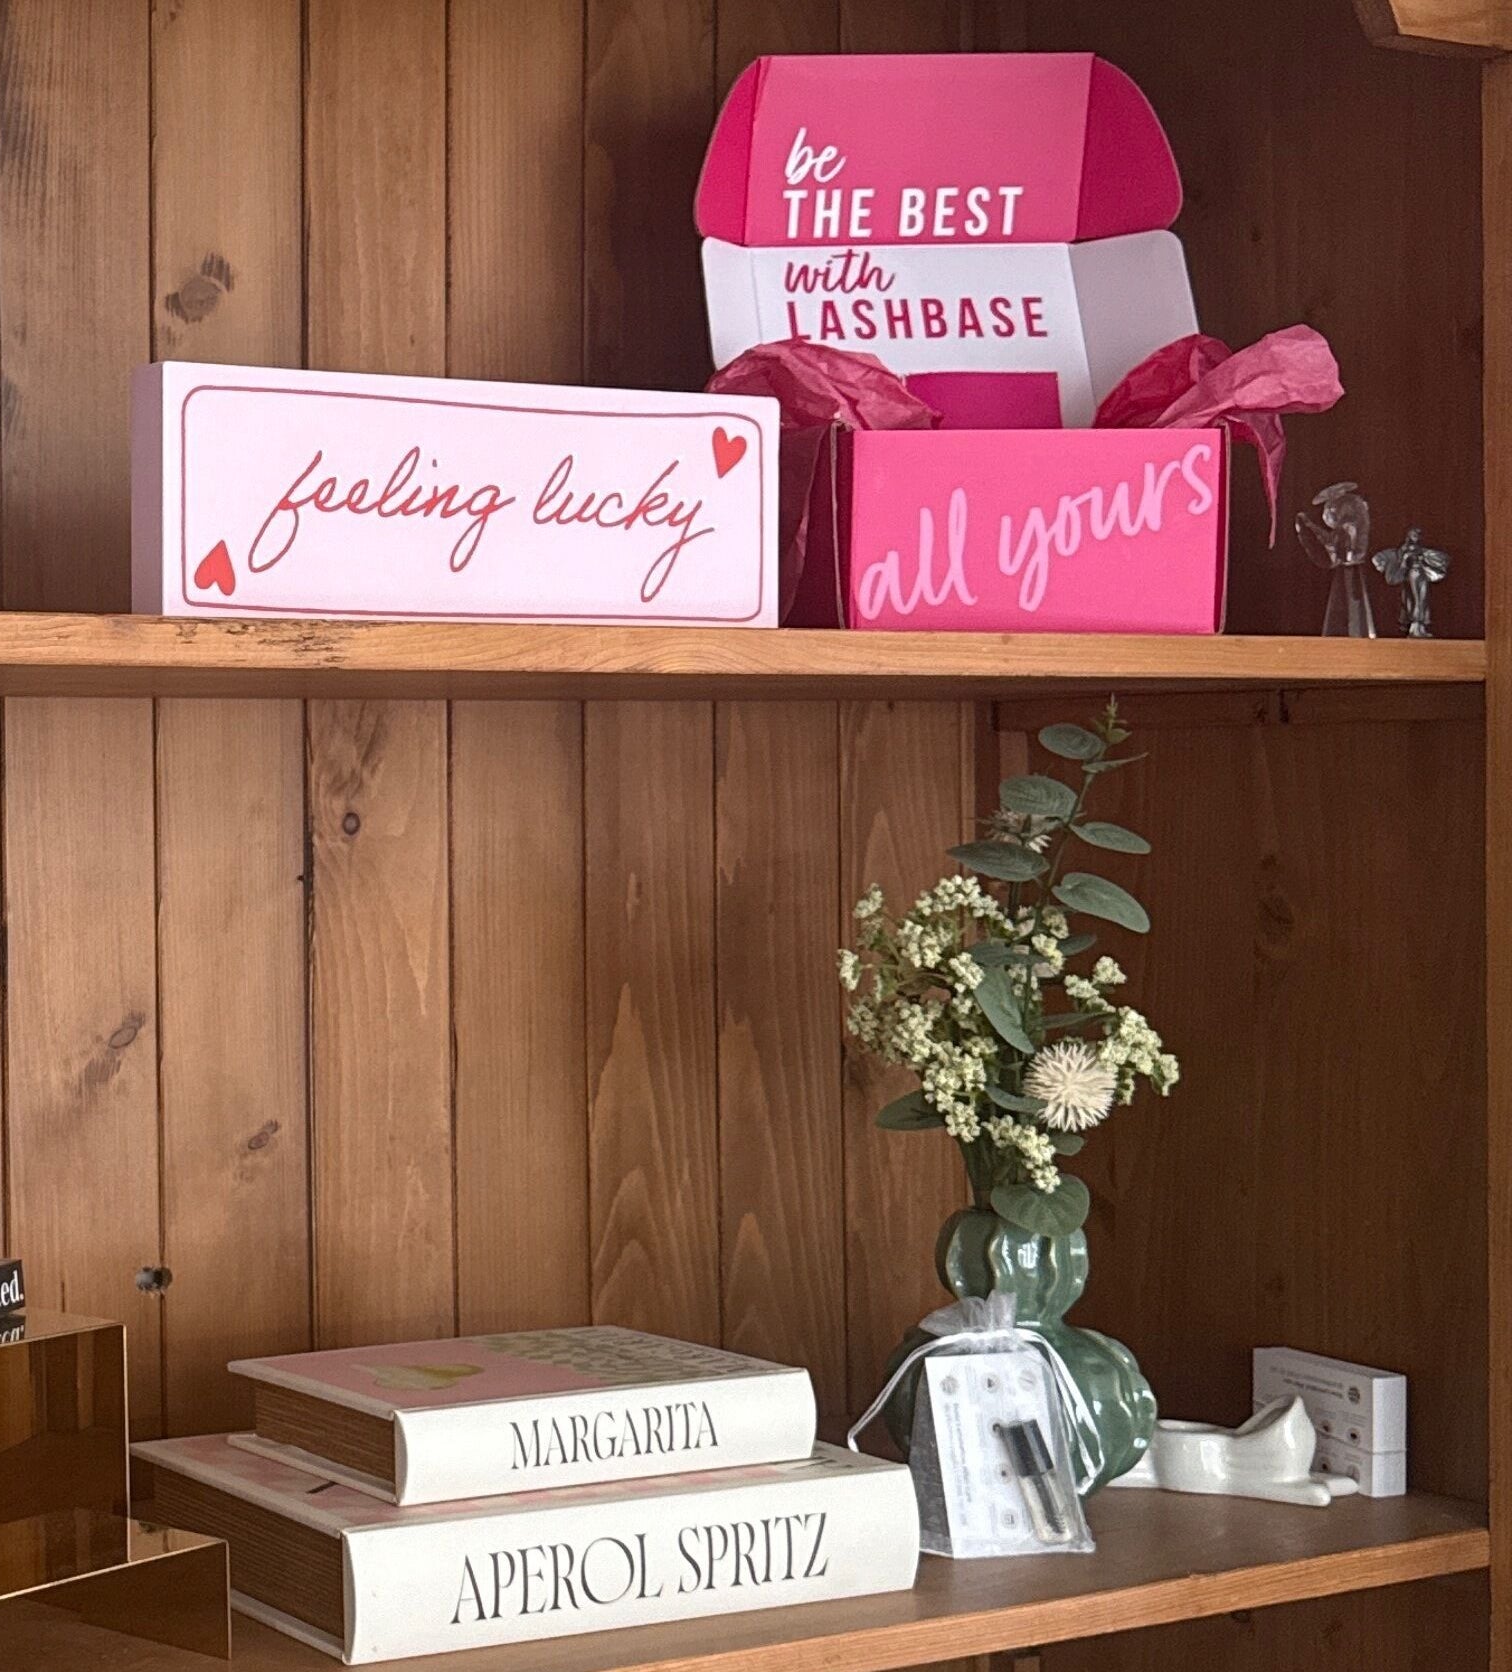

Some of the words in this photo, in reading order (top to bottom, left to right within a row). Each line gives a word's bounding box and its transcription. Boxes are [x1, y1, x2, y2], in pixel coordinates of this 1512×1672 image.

[785, 126, 846, 185] be
[783, 188, 875, 238] THE
[899, 186, 1024, 237] BEST
[785, 248, 896, 293] with
[787, 297, 1048, 340] LASHBASE
[248, 446, 515, 573] feeling
[533, 455, 715, 602] lucky
[858, 487, 978, 620] all
[997, 443, 1213, 612] yours
[510, 1400, 719, 1470] MARGARITA
[450, 1533, 664, 1625] APEROL
[678, 1512, 830, 1596] SPRITZ
